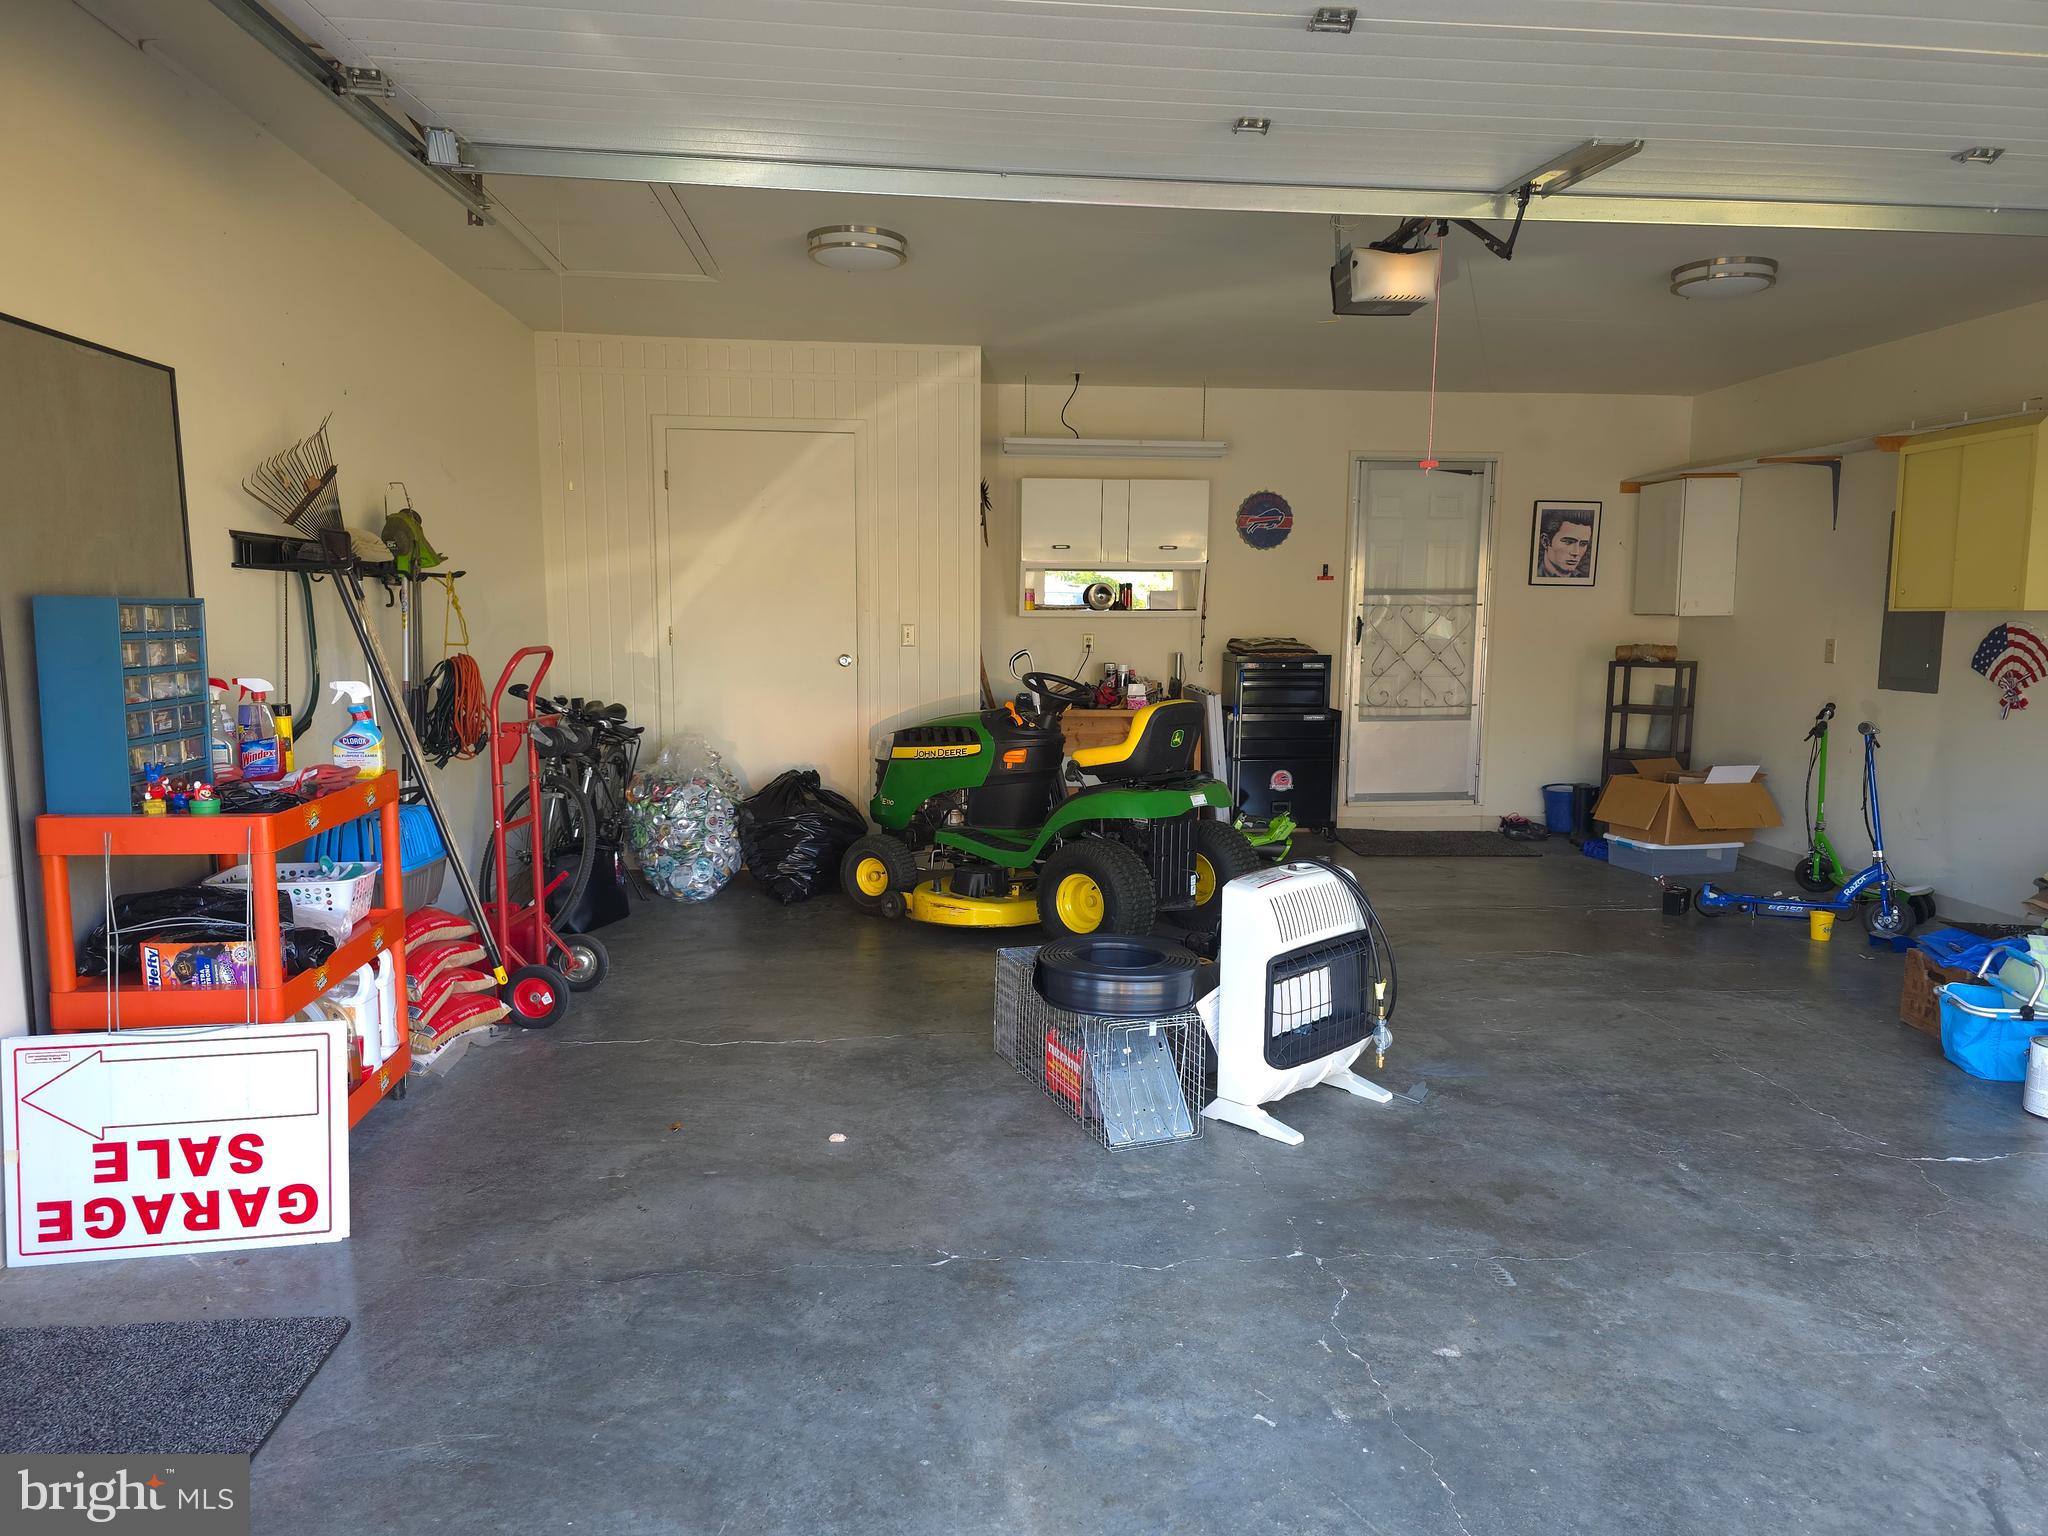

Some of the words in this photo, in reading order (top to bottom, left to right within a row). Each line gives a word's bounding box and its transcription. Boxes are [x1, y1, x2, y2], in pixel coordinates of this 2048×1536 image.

[342, 737, 367, 745] CLOROX
[242, 750, 274, 768] Windex
[914, 748, 936, 758] JOHN
[937, 747, 968, 757] DEERE
[1843, 874, 1867, 896] Razor
[145, 949, 160, 986] Hefty
[92, 1133, 264, 1183] SALE
[36, 1182, 319, 1243] GARAGE
